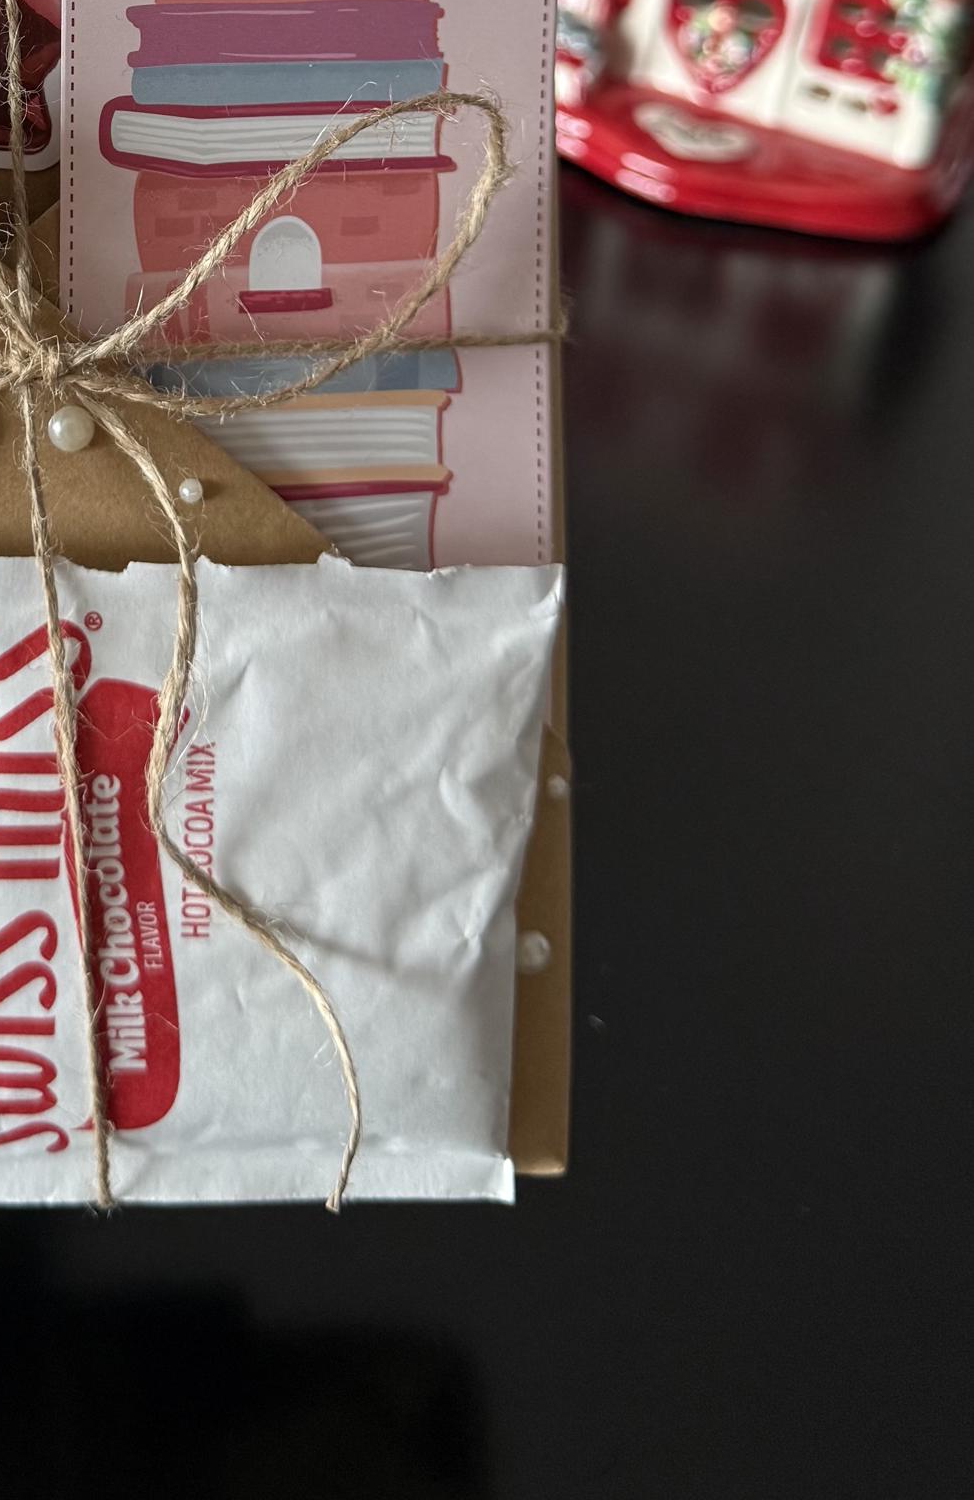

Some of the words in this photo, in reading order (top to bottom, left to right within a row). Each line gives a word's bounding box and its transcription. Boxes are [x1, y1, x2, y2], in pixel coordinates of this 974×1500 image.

[185, 741, 217, 792] MIX
[85, 773, 141, 986] Chocolate
[180, 887, 212, 939] HOT
[136, 900, 164, 971] FLAVOR
[105, 989, 148, 1072] Milk
